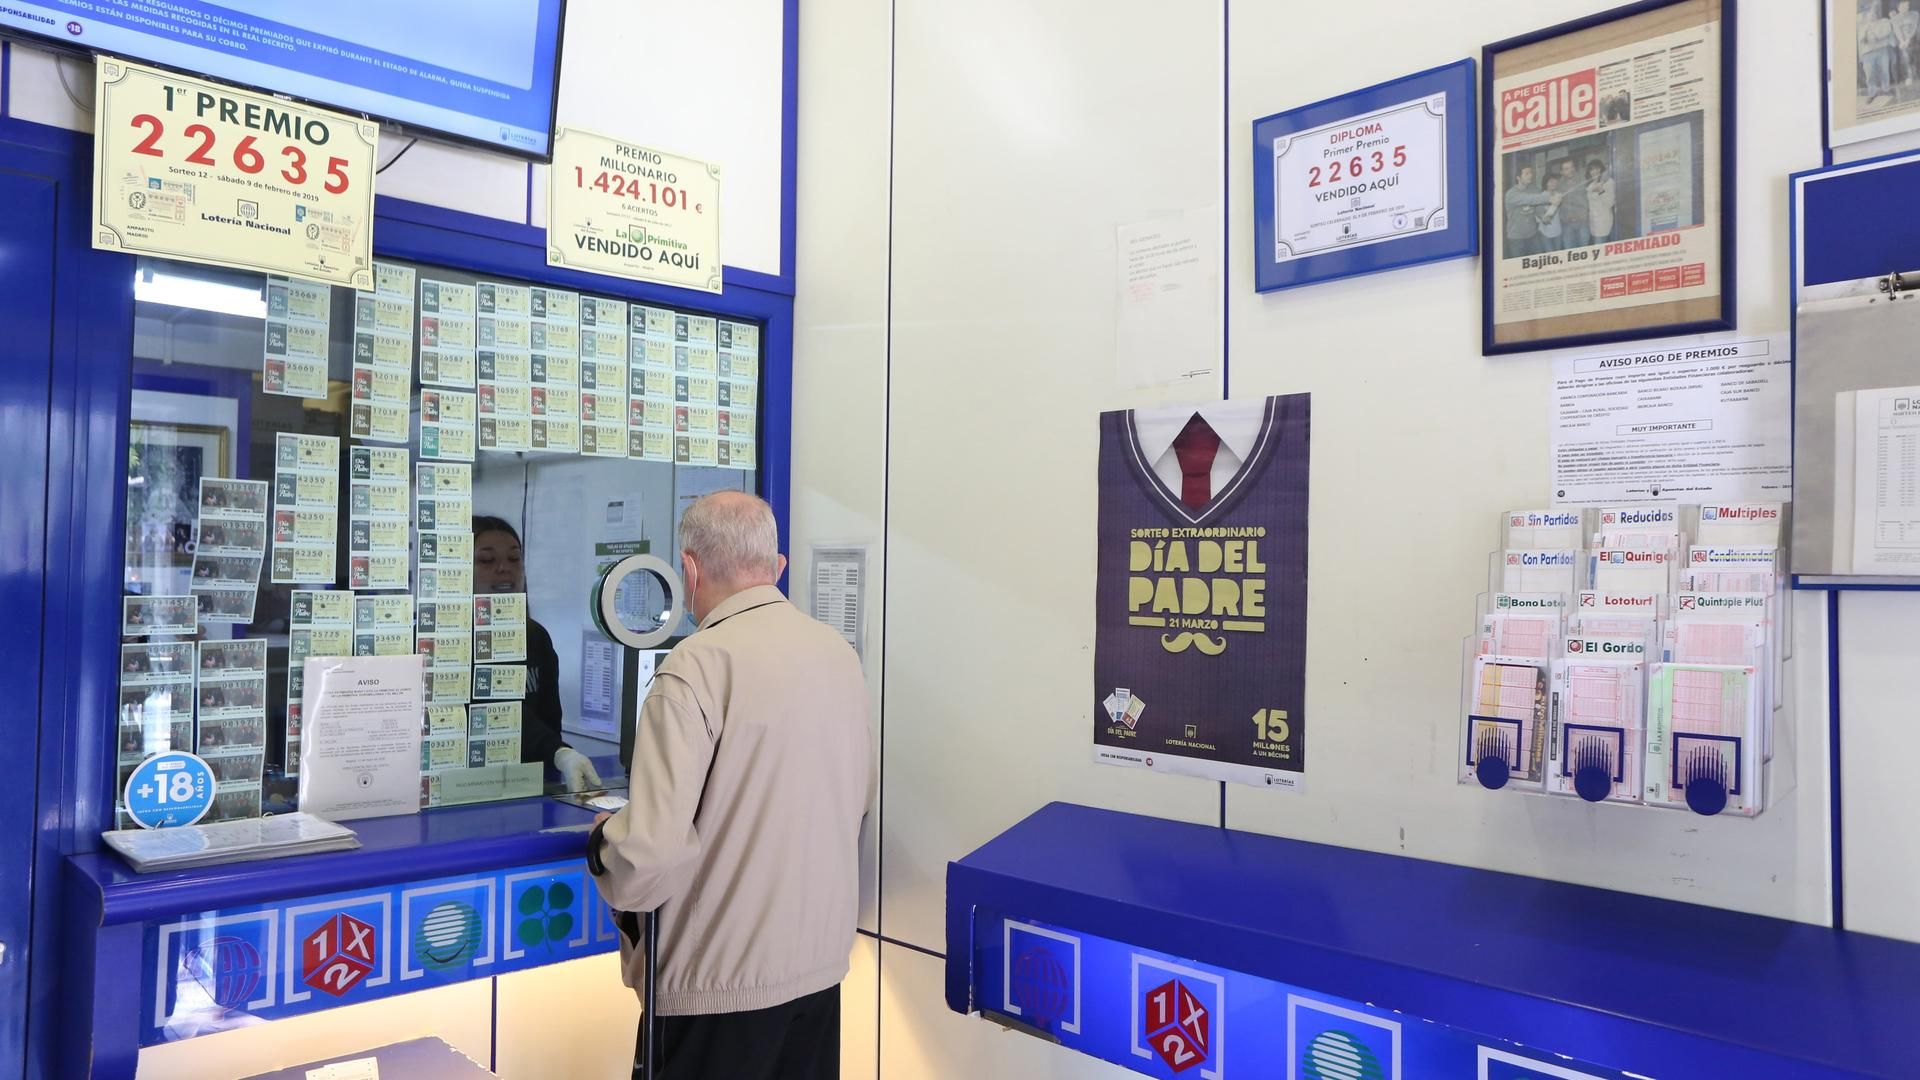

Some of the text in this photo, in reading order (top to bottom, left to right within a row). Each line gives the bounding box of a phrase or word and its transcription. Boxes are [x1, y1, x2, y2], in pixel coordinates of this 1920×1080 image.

[96, 5, 124, 19] ESTÁN
[126, 13, 180, 33] DISPONIBLES
[182, 28, 204, 40] PARA
[206, 34, 217, 42] SU
[171, 14, 217, 30] RECOGIDAS
[1504, 83, 1547, 102] A PIE DE
[1504, 78, 1593, 134] calle
[196, 91, 330, 146] PREMIO
[1330, 122, 1384, 145] DIPLOMA
[616, 144, 662, 166] PREMIO
[1323, 136, 1390, 159] Primer Premio
[600, 156, 677, 184] MILLONARIO
[1308, 144, 1407, 188] 22635
[168, 166, 196, 178] Sorteo
[198, 170, 208, 179] 12
[216, 174, 245, 186] sábado
[254, 180, 262, 189] de
[264, 182, 291, 196] febrero
[292, 190, 302, 198] de
[575, 165, 688, 211] 1.424.101
[1315, 172, 1400, 203] VENDIDO AQUÍ
[628, 204, 658, 217] ACIERTOS
[201, 212, 291, 236] Lotería Nacional
[616, 228, 627, 239] La
[648, 234, 688, 250] Primitiva
[574, 233, 700, 270] VENDIDO AQUÍ
[1522, 233, 1681, 270] Bajito, feo y PREMIADO
[1599, 346, 1738, 368] AVISO PAGO DE PREMIOS
[1648, 422, 1696, 432] IMPORTANTE
[299, 440, 326, 448] 42350
[298, 476, 325, 484] 42350
[296, 512, 324, 520] 42350
[1528, 512, 1579, 526] Sin Partidos
[1620, 510, 1673, 524] Reducidos
[1130, 526, 1266, 538] SORTEO EXTRAORDINARIO
[296, 548, 322, 556] 42350
[1128, 539, 1266, 574] DÍA DEL
[1522, 552, 1576, 565] Con Partidos
[1600, 551, 1610, 562] El
[1128, 576, 1266, 618] PADRE
[1511, 599, 1538, 608] Bono
[1604, 596, 1652, 606] Lototurf
[1744, 597, 1764, 607] Plus
[1169, 618, 1219, 630] 21 MARZO
[1585, 642, 1644, 654] El Gordo
[1252, 708, 1290, 742] 15
[1166, 738, 1216, 750] LOTERÍA NACIONAL
[1253, 741, 1290, 752] MILLONES
[136, 772, 194, 804] +18
[194, 771, 205, 799] AÑOS
[312, 921, 371, 960] 1 X
[1152, 992, 1167, 1025] 1
